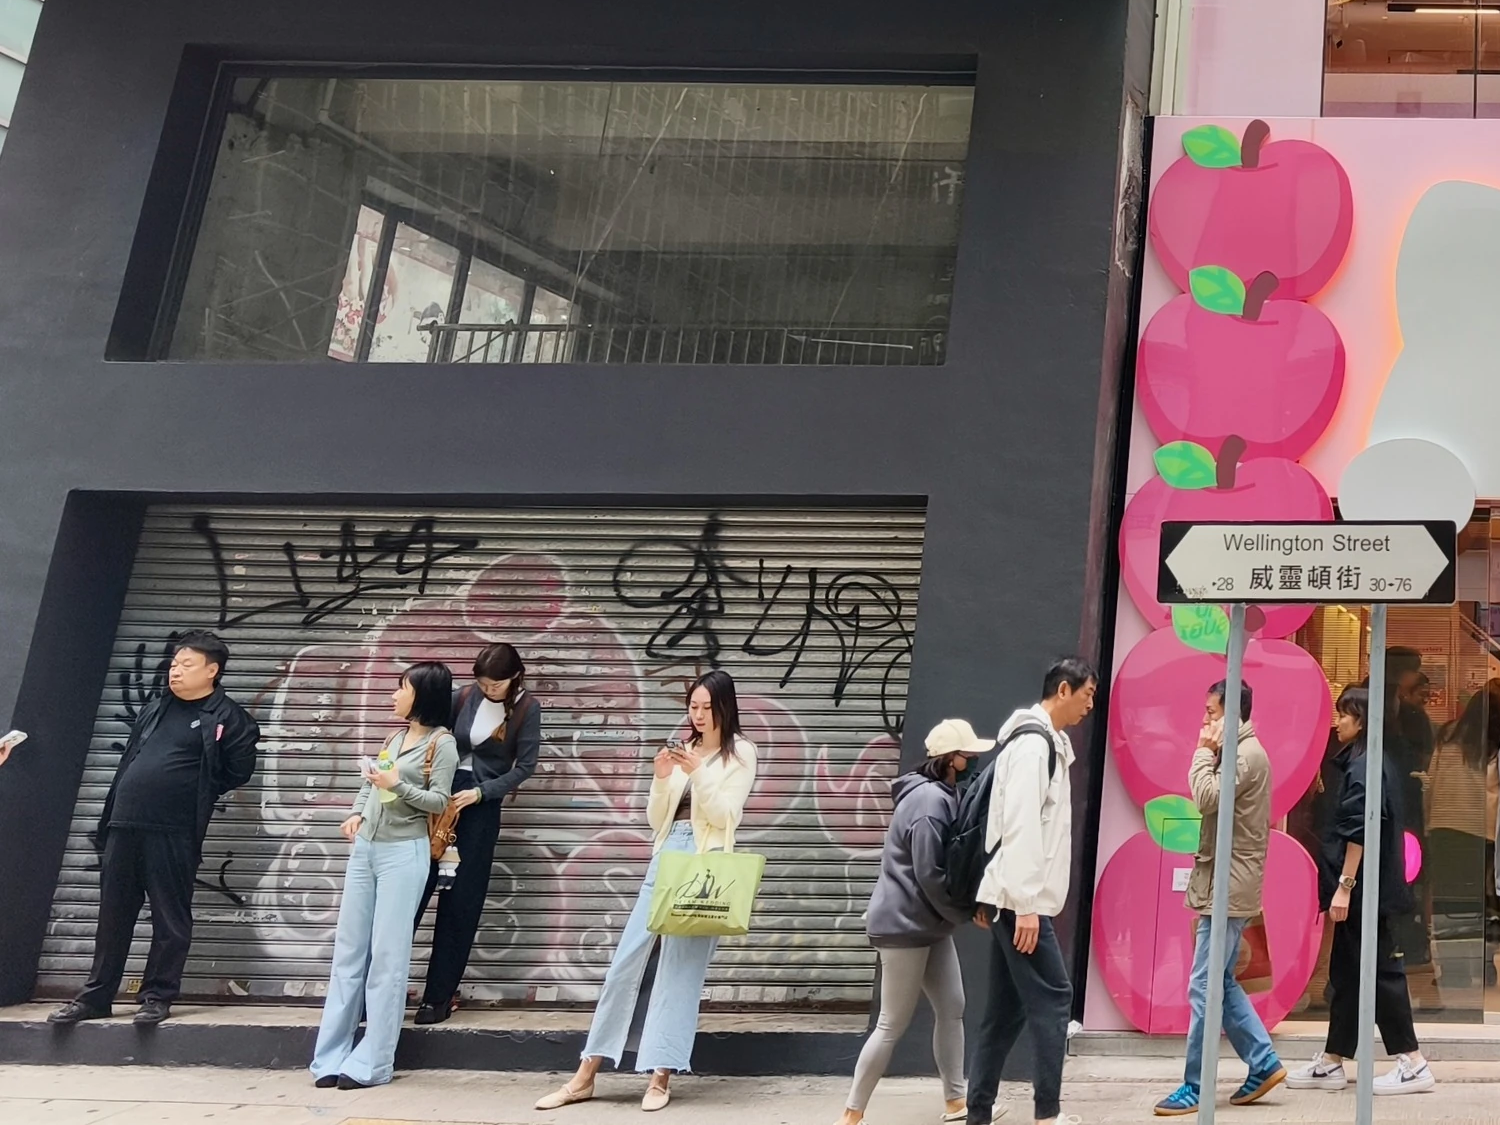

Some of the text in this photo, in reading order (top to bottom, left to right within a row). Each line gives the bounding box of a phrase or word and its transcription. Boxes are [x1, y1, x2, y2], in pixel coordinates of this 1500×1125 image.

[1223, 534, 1391, 555] Wellington Street
[1249, 565, 1362, 591] 威靈頓街
